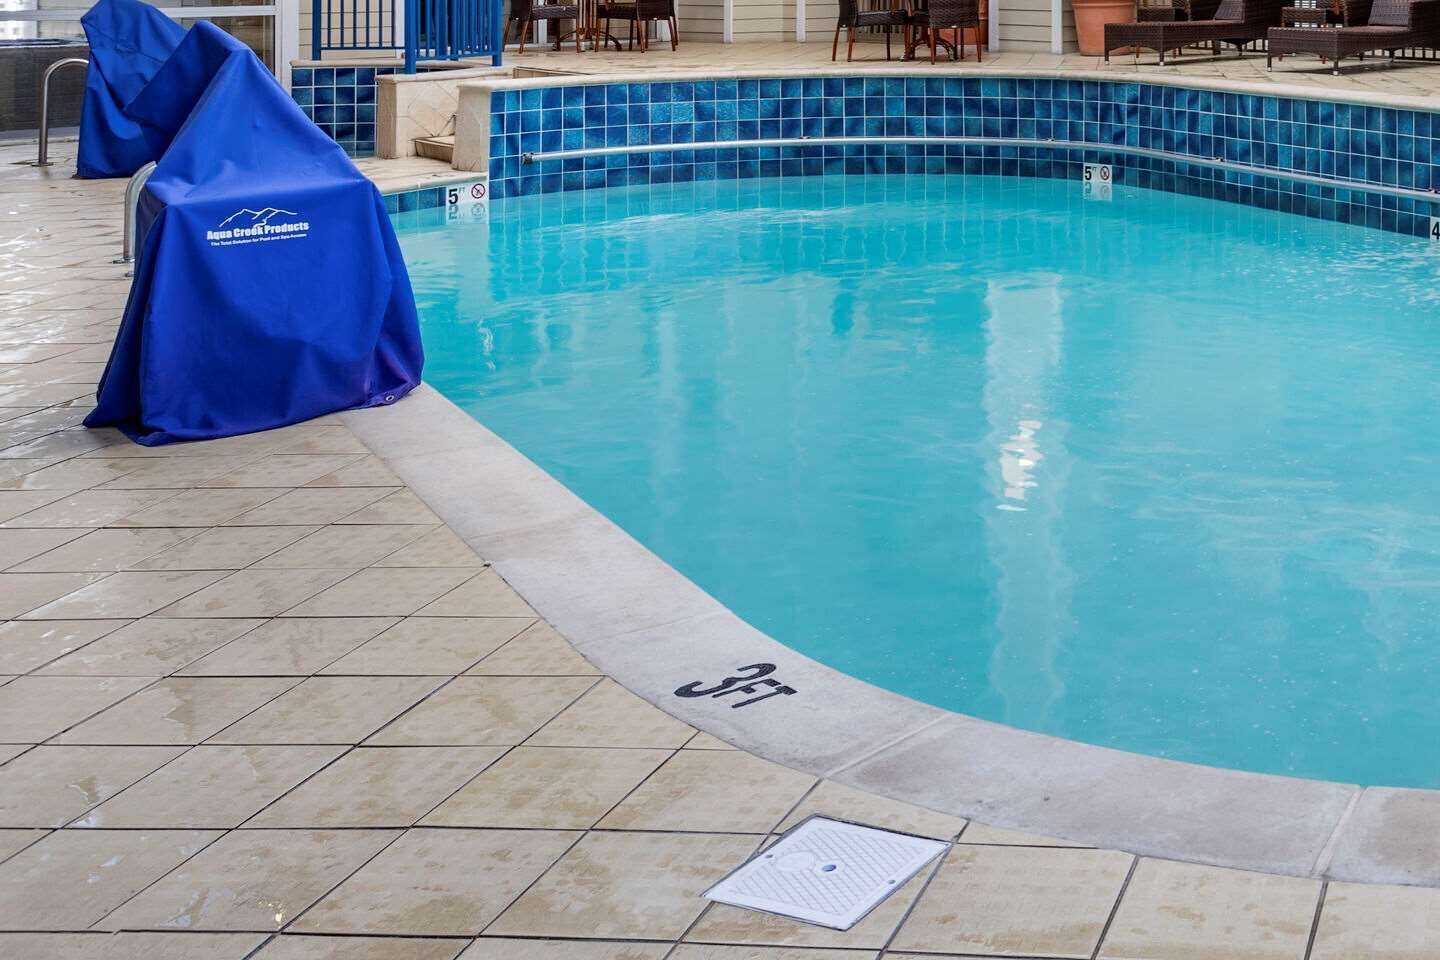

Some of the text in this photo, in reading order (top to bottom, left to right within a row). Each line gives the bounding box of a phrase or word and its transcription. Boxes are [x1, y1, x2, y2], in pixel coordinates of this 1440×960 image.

[206, 221, 310, 241] Aqua Creek Products
